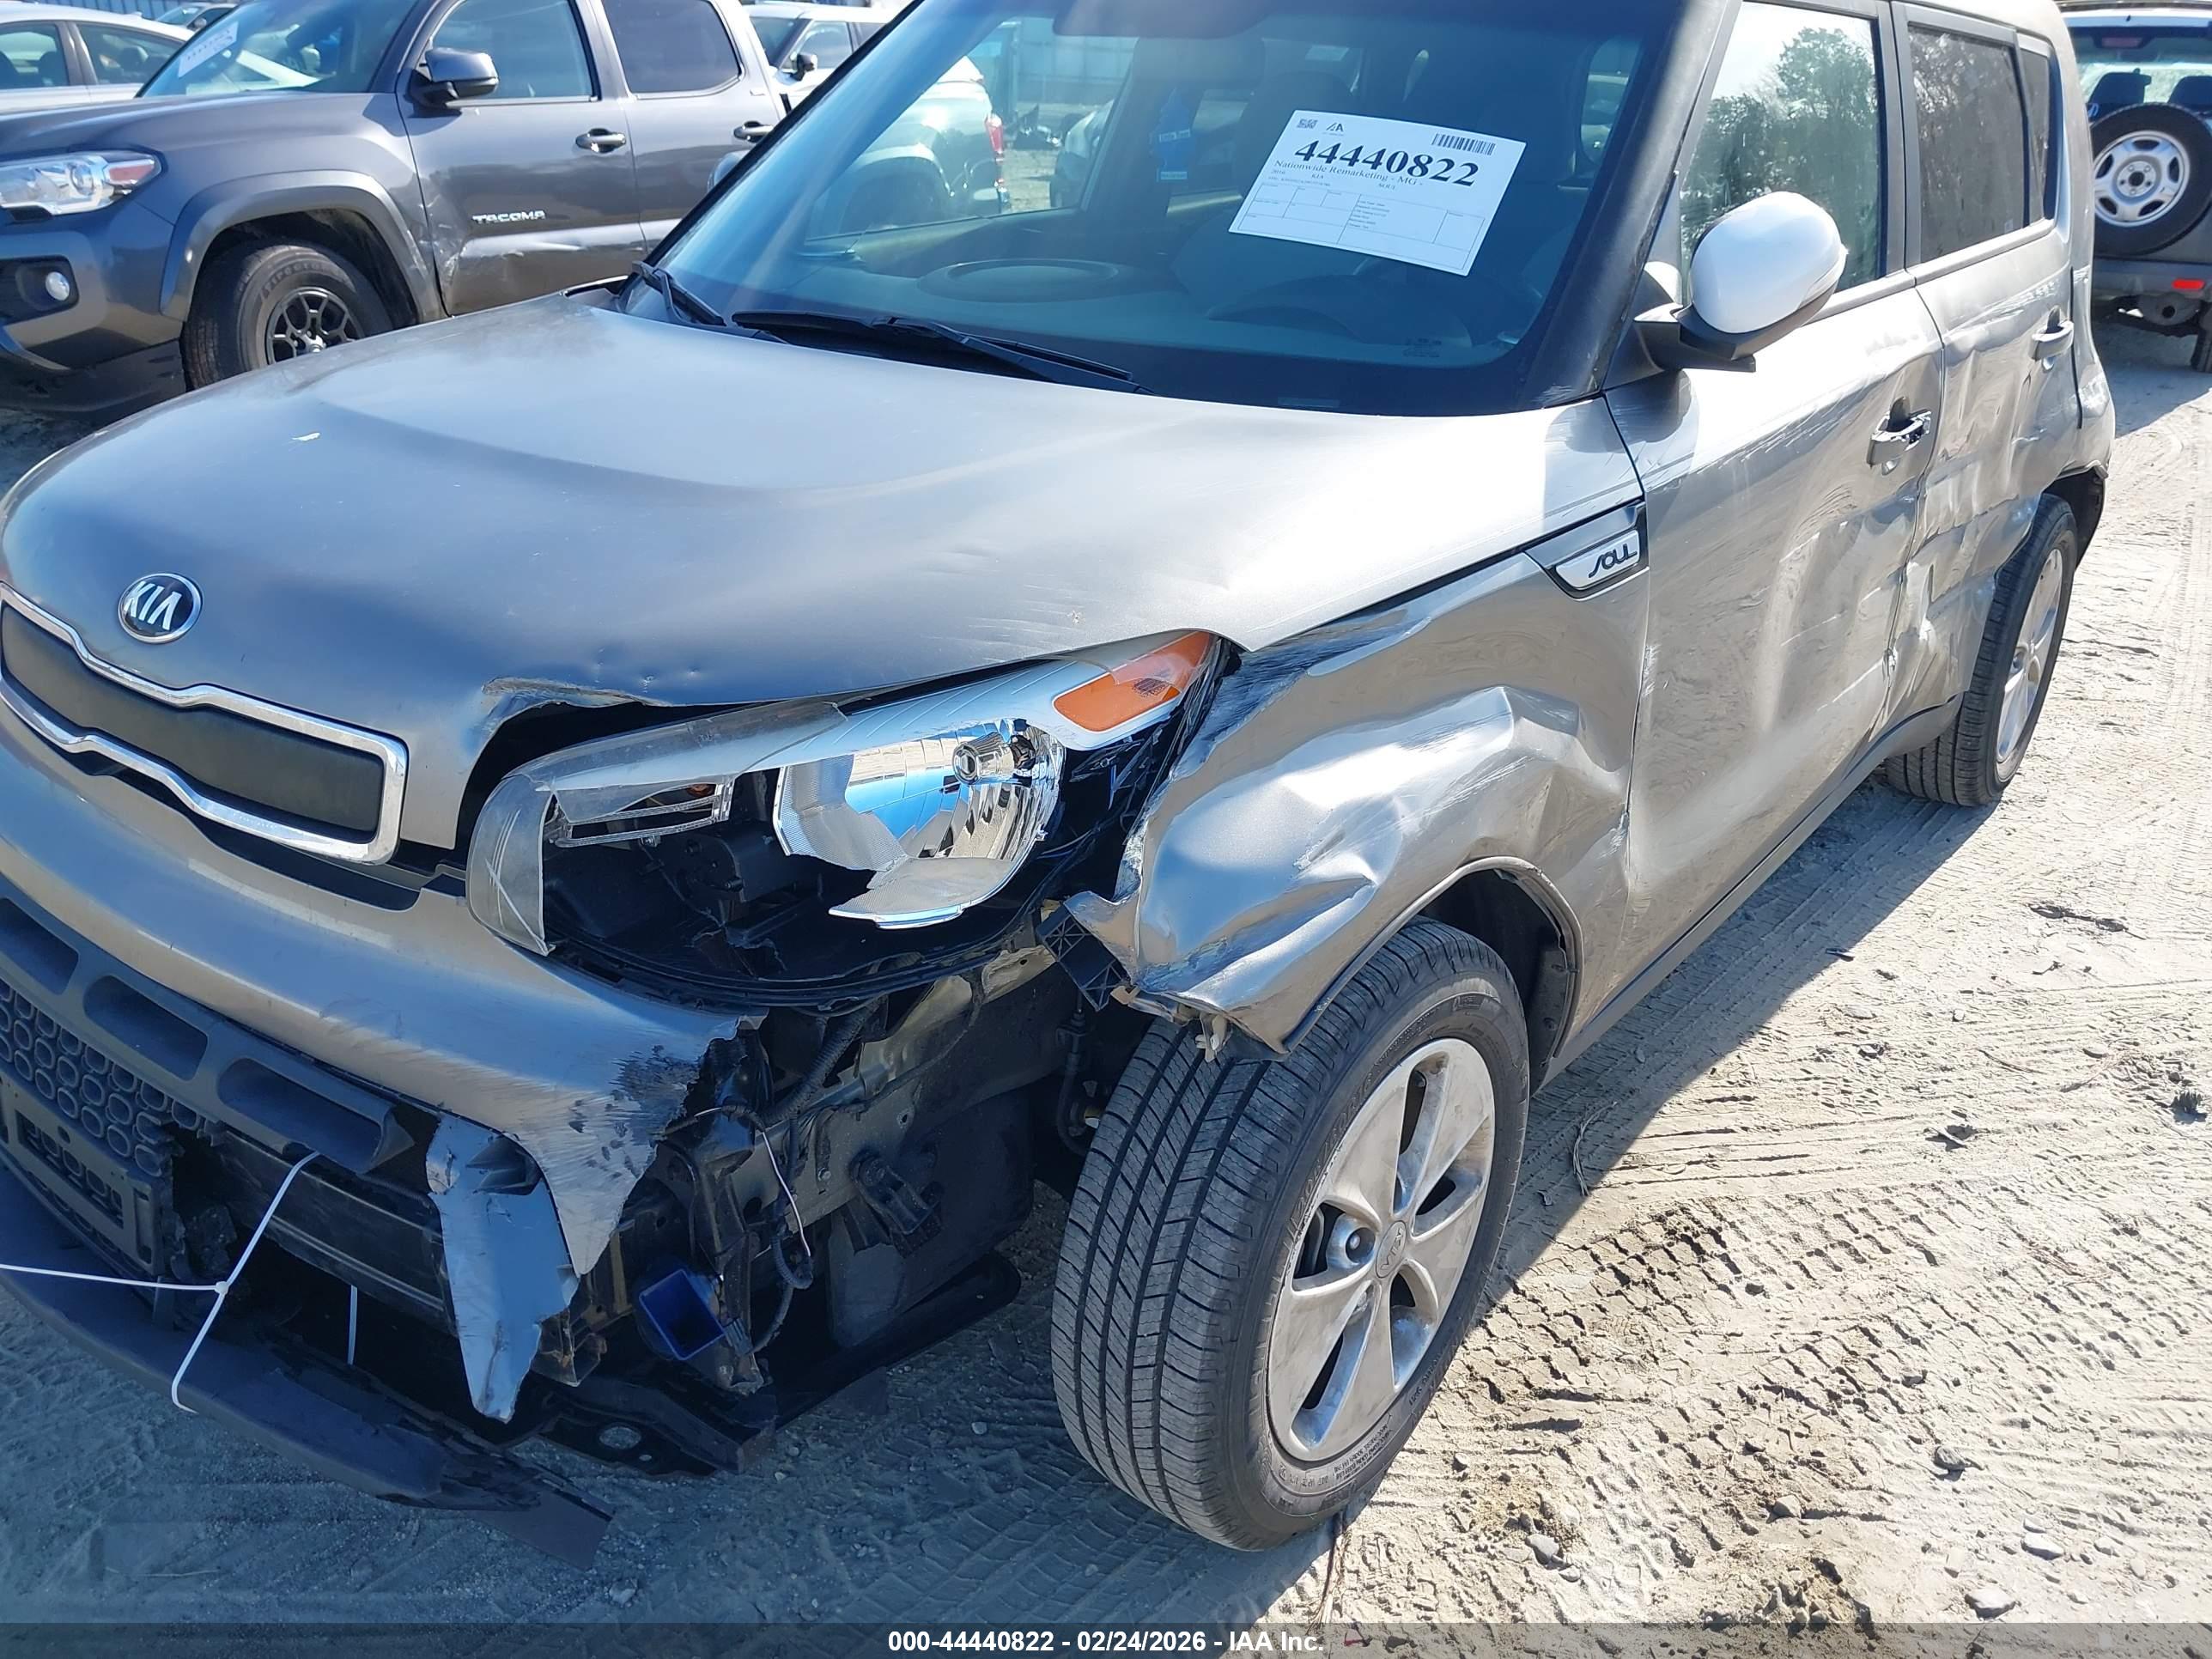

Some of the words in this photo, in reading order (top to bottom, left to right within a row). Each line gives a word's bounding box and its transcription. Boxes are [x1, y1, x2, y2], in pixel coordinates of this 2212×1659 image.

[1273, 160, 1328, 173] Nationwide
[1329, 166, 1388, 182] Remarketing
[1295, 140, 1480, 187] 44440822
[471, 210, 546, 224] TACOMA
[123, 580, 182, 631] KIA
